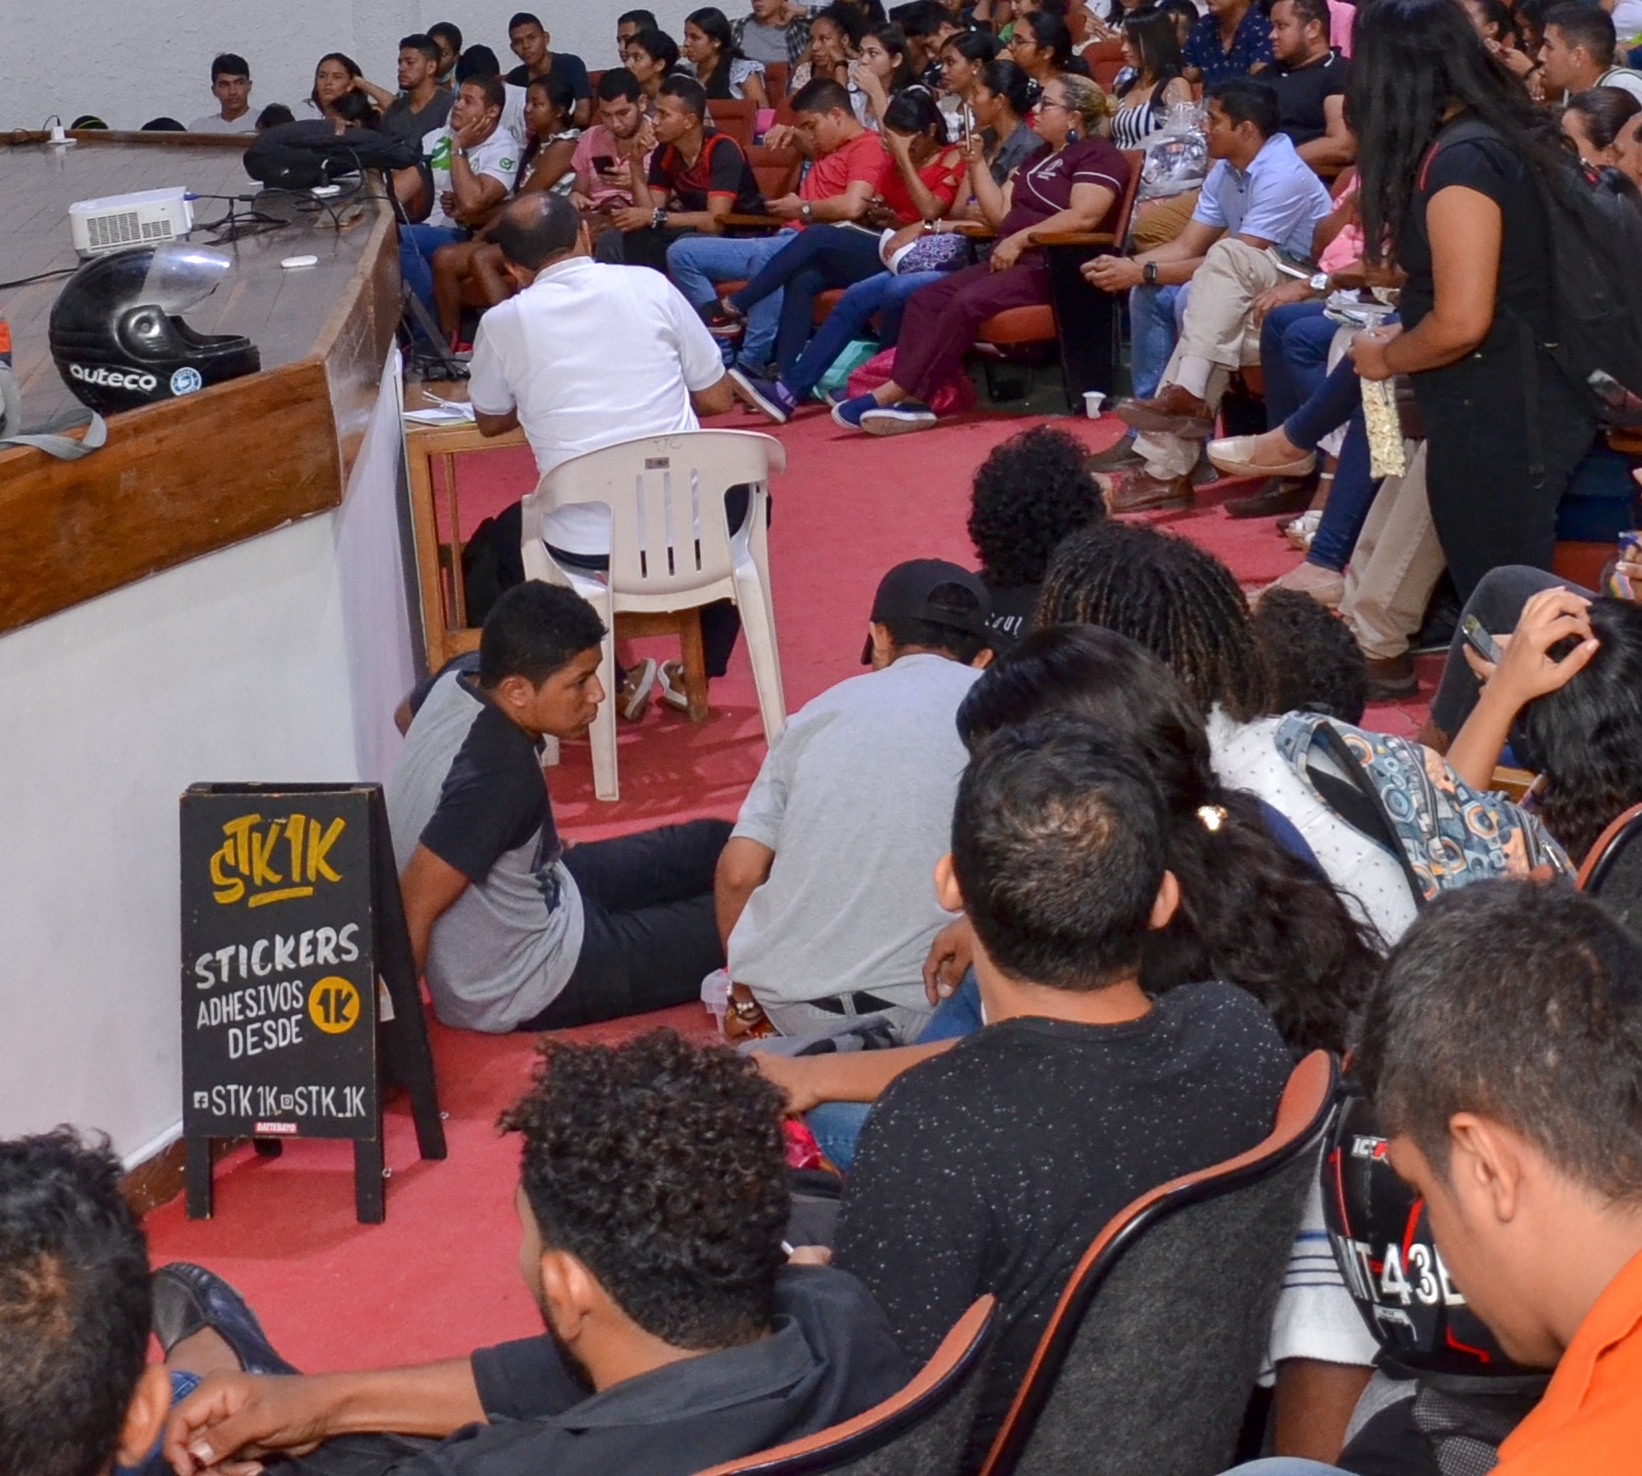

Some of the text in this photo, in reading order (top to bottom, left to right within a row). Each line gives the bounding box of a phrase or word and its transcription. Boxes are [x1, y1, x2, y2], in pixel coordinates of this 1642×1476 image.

[70, 364, 157, 391] auteco
[210, 812, 345, 905] STK1K
[194, 922, 360, 990] STICKERS
[196, 980, 304, 1029] ADHESIVOS
[317, 990, 355, 1024] 1K
[228, 1014, 303, 1059] DESDE
